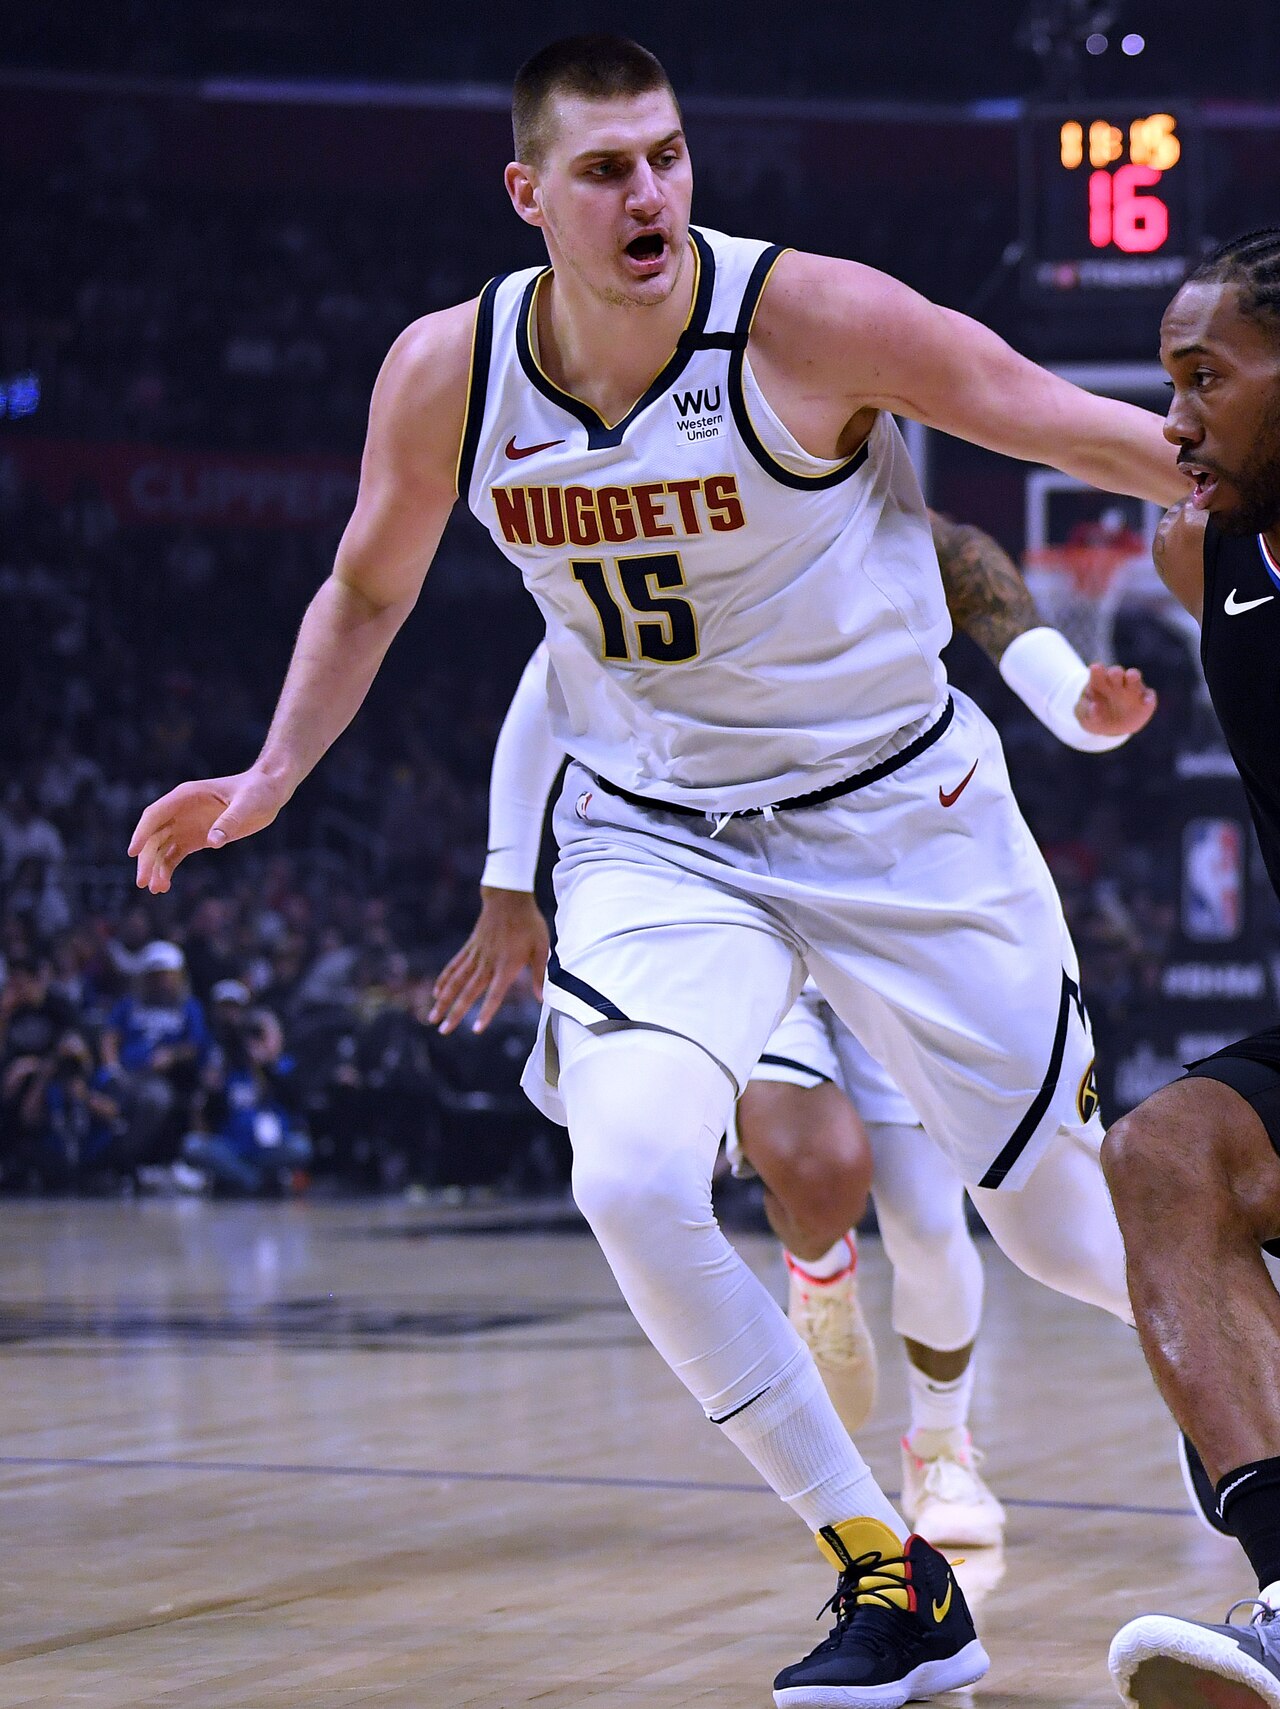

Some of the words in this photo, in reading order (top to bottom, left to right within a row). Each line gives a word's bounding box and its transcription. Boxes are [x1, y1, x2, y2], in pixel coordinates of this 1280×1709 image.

[1088, 163, 1170, 253] 16
[673, 386, 721, 417] WU
[677, 415, 723, 431] Western
[687, 428, 719, 441] Union
[490, 474, 747, 547] NUGGETS
[568, 551, 701, 665] 15
